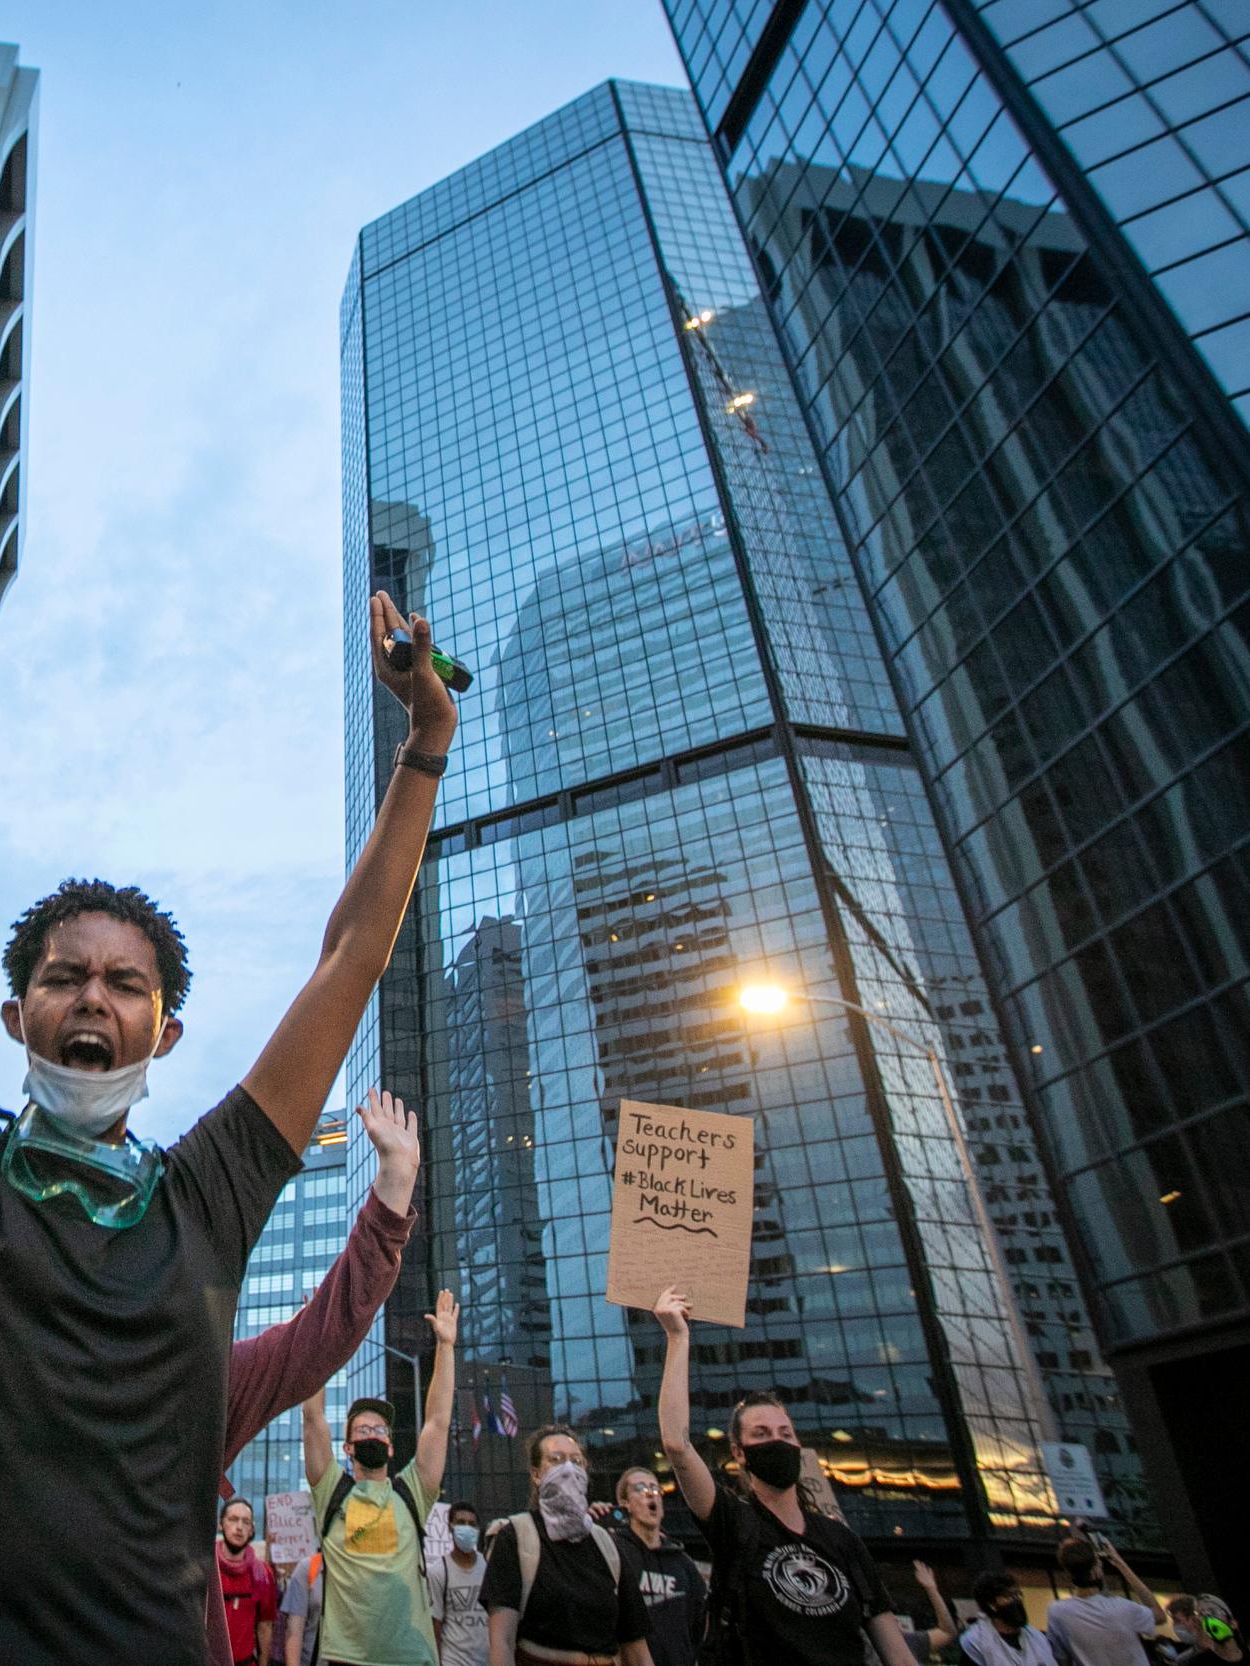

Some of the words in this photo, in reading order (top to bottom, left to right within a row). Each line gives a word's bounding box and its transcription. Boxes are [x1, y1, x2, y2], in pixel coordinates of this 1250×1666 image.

[629, 1113, 737, 1150] Teachers
[621, 1170, 687, 1194] #Black
[690, 1181, 737, 1205] Lives
[639, 1193, 714, 1223] Matter
